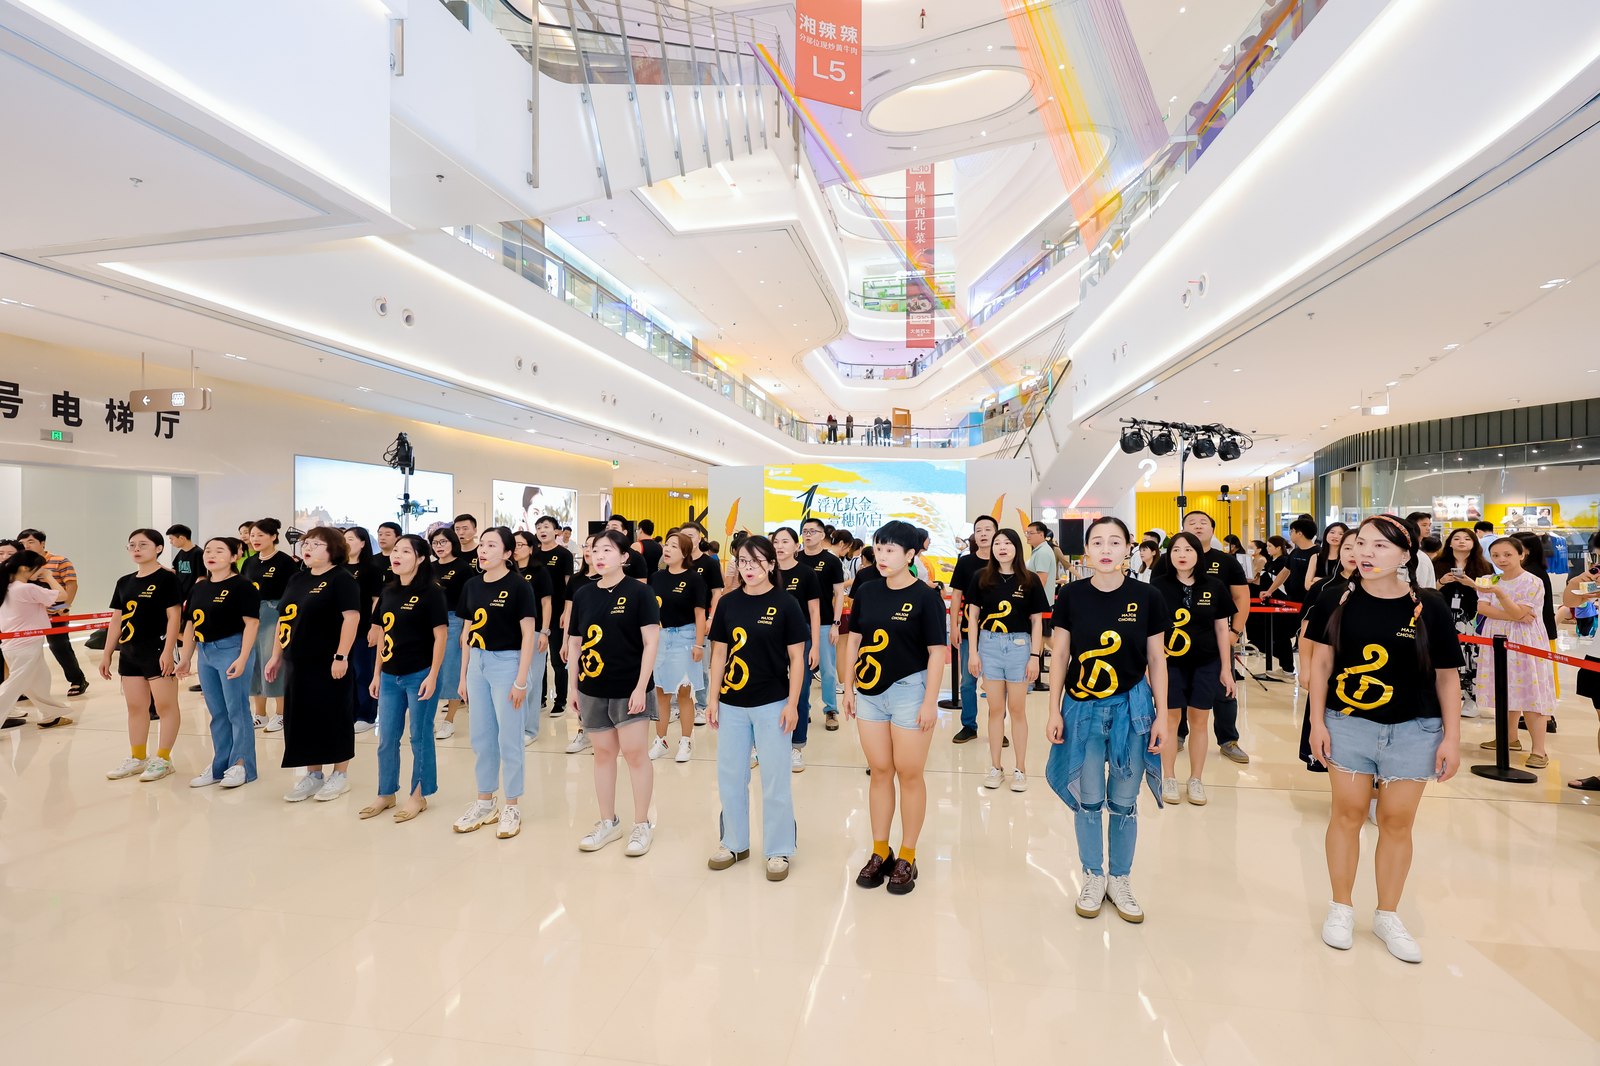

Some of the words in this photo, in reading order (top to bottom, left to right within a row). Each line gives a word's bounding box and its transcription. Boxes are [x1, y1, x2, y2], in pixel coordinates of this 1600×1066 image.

[799, 12, 858, 45] 湘辣辣
[812, 55, 846, 82] L5
[914, 180, 927, 244] 风味西北菜
[817, 496, 872, 513] 浮光跃金
[498, 591, 508, 599] D
[1203, 591, 1212, 599] D
[617, 597, 627, 605] D
[766, 606, 777, 616] D
[901, 603, 913, 612] D
[1127, 602, 1138, 612] D
